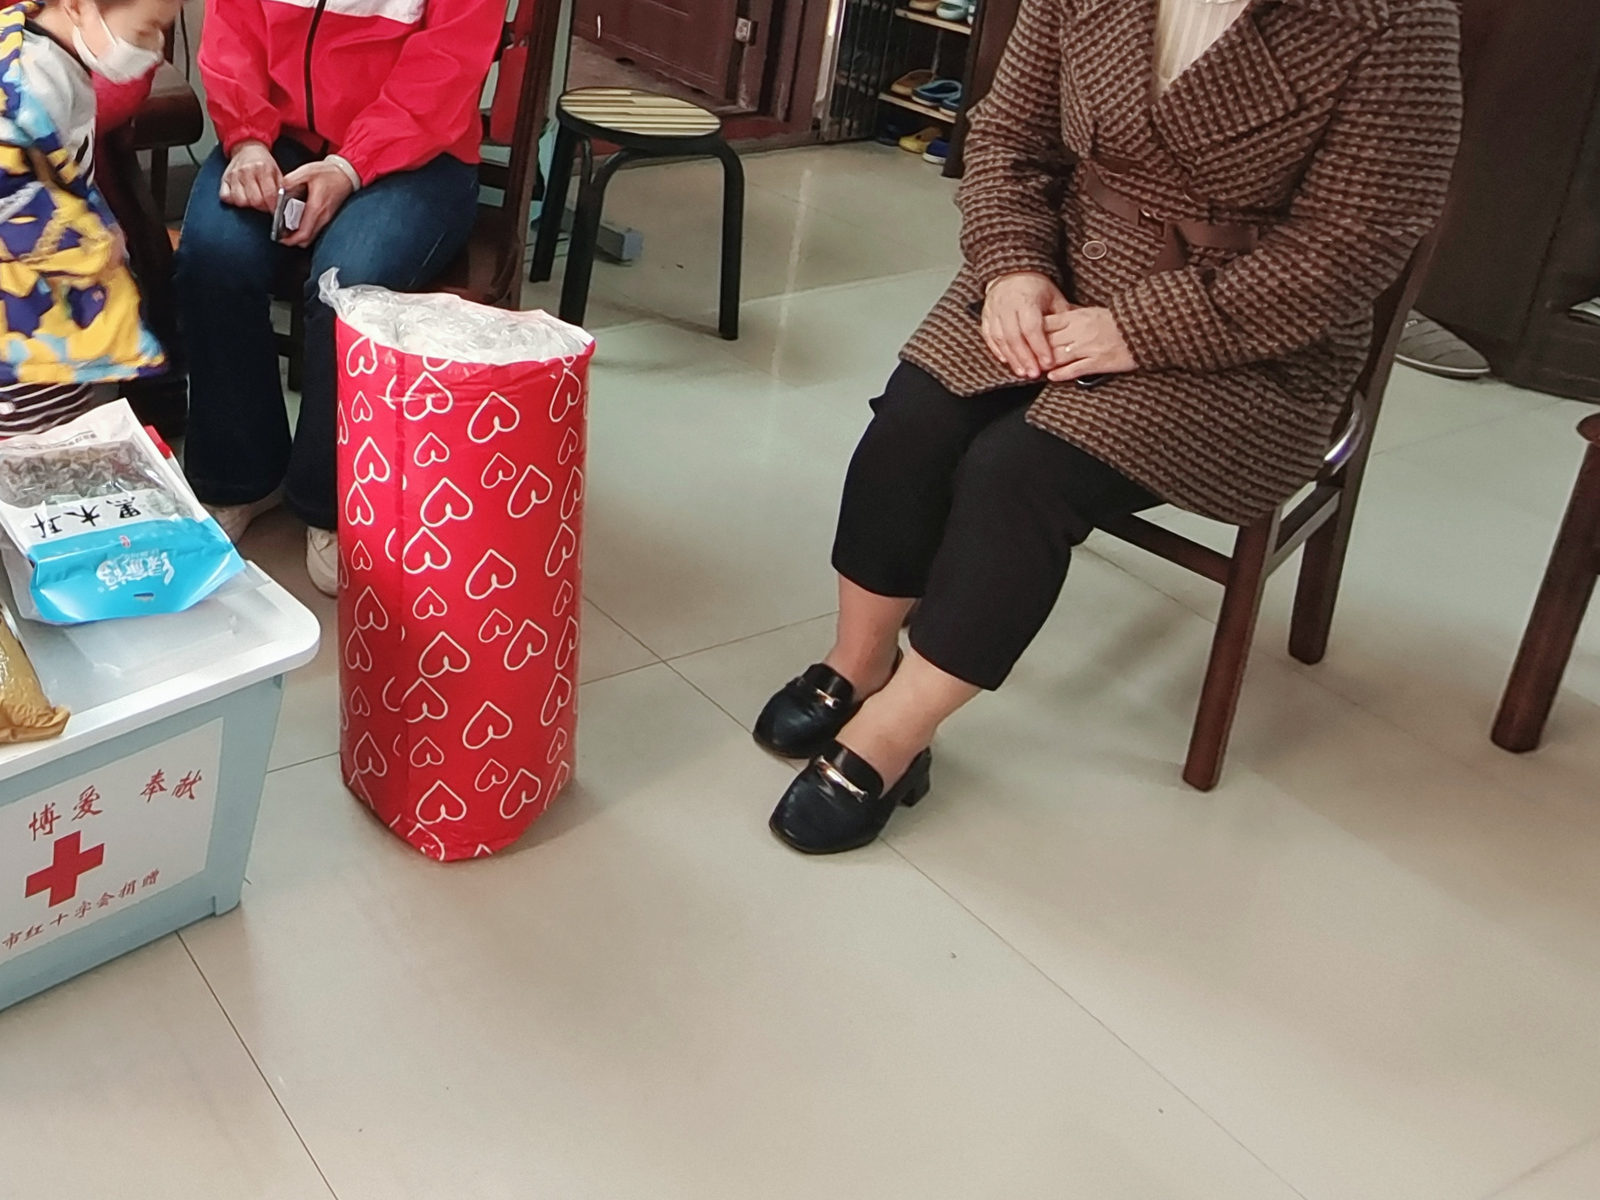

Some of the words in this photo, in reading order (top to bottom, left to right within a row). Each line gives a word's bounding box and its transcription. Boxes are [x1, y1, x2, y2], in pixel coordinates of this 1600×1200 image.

[30, 495, 142, 539] 黑木耳
[27, 784, 104, 841] 博爱
[139, 768, 203, 803] 奉献
